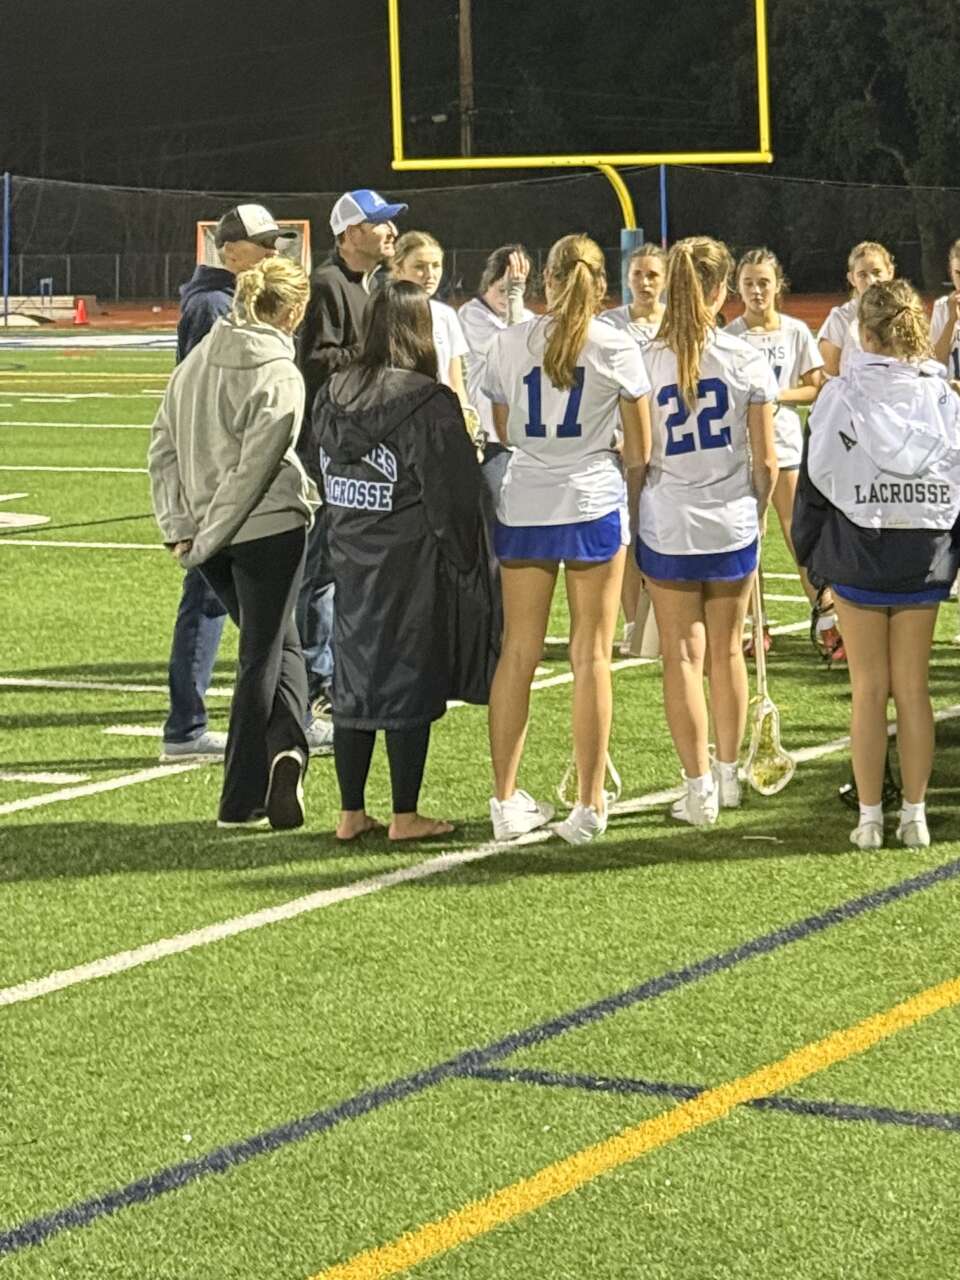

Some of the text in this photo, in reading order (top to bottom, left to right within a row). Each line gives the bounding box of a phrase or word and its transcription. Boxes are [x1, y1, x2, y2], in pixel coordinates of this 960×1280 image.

[523, 366, 586, 438] 17
[657, 377, 733, 456] 22
[854, 483, 952, 505] LACROSSE
